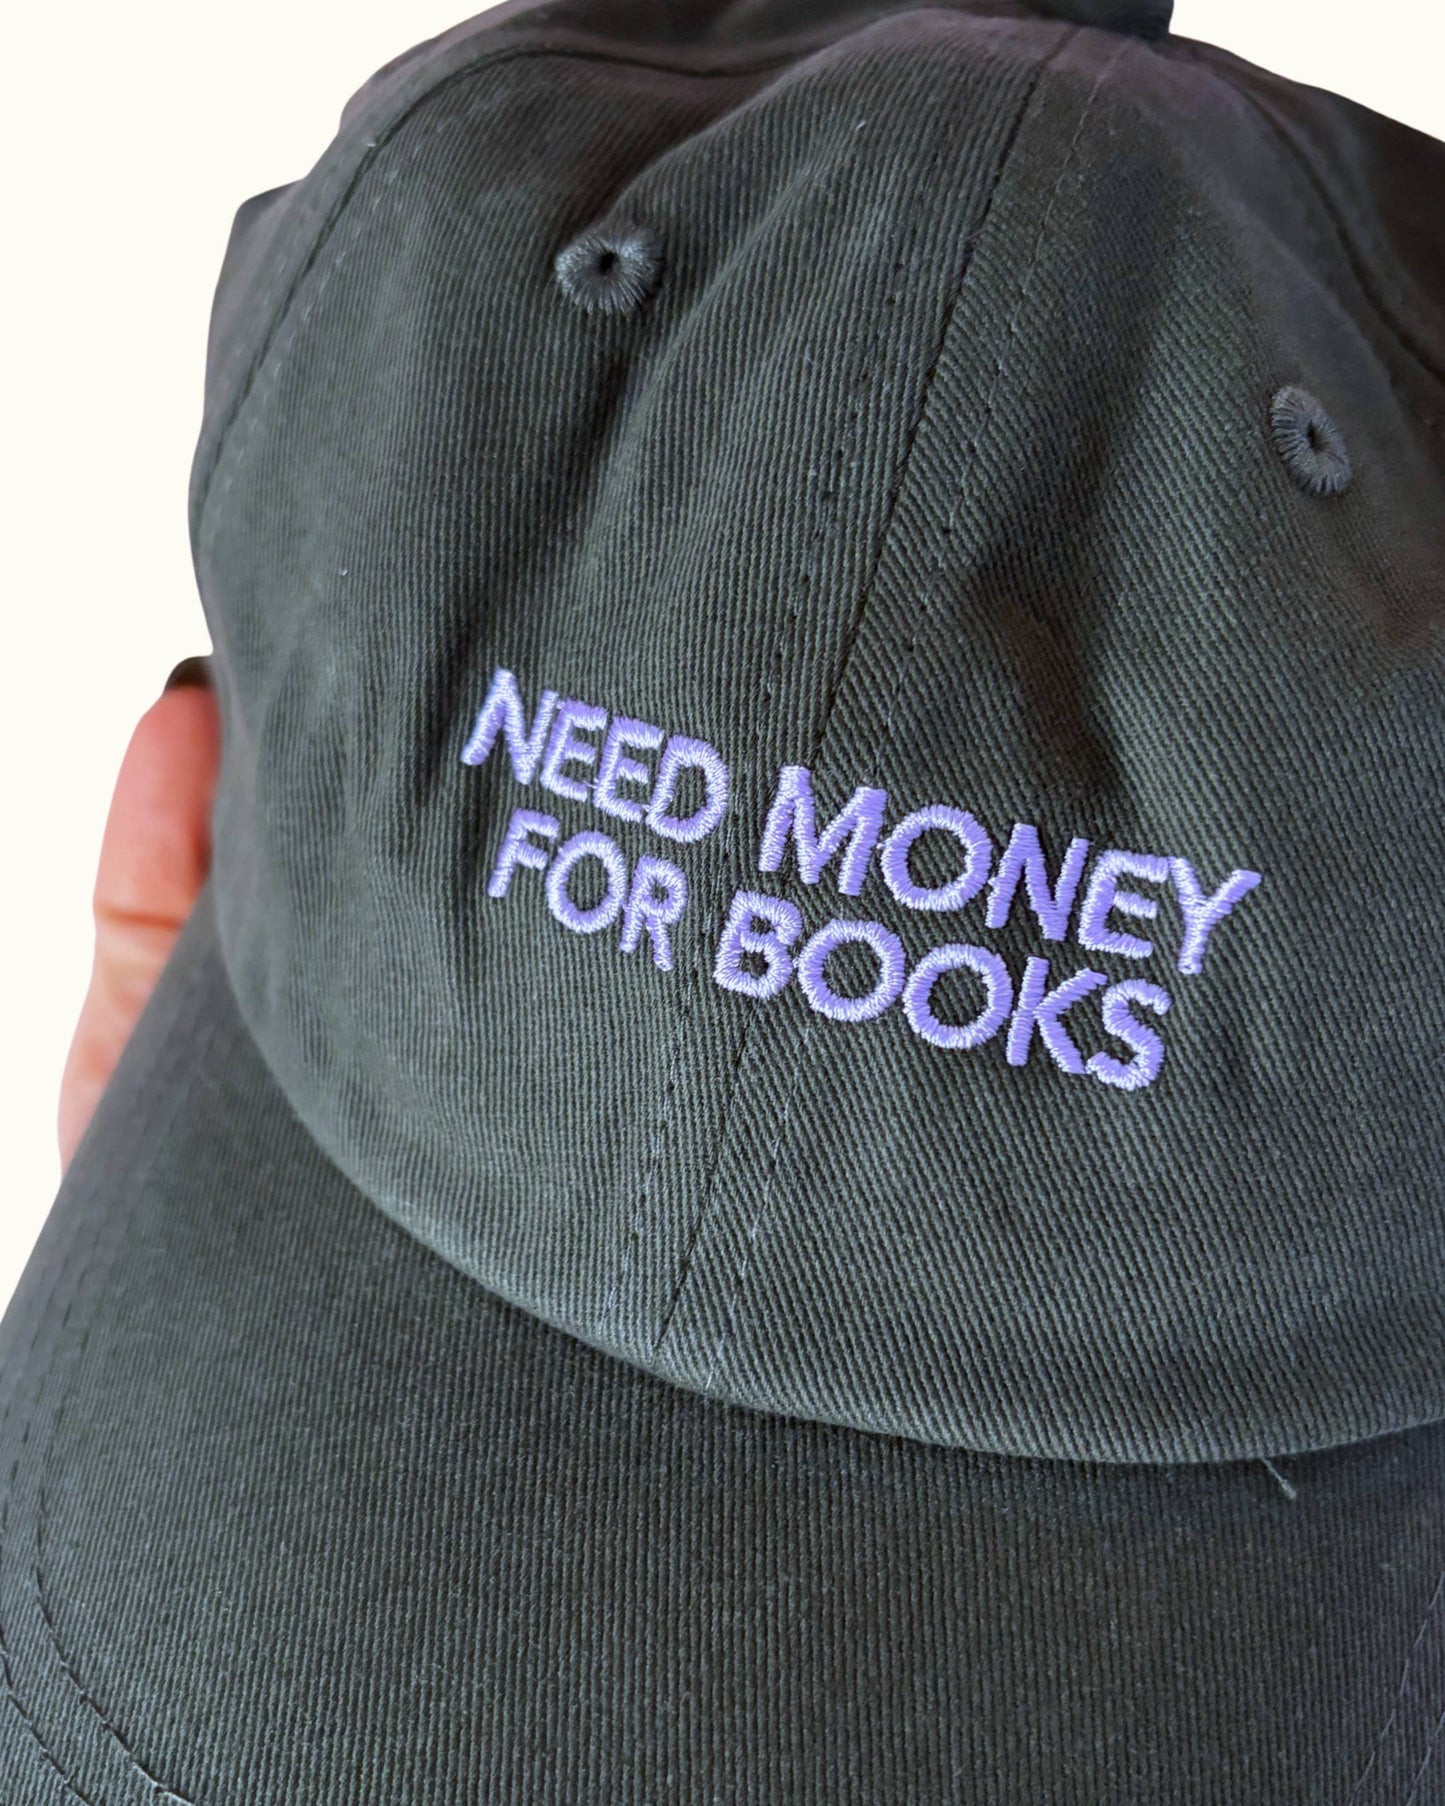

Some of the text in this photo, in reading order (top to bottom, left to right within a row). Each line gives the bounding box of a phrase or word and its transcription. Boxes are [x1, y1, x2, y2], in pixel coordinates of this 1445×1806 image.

[460, 667, 1262, 976] NEED MONEY
[487, 808, 1172, 1092] FOR BOOKS
